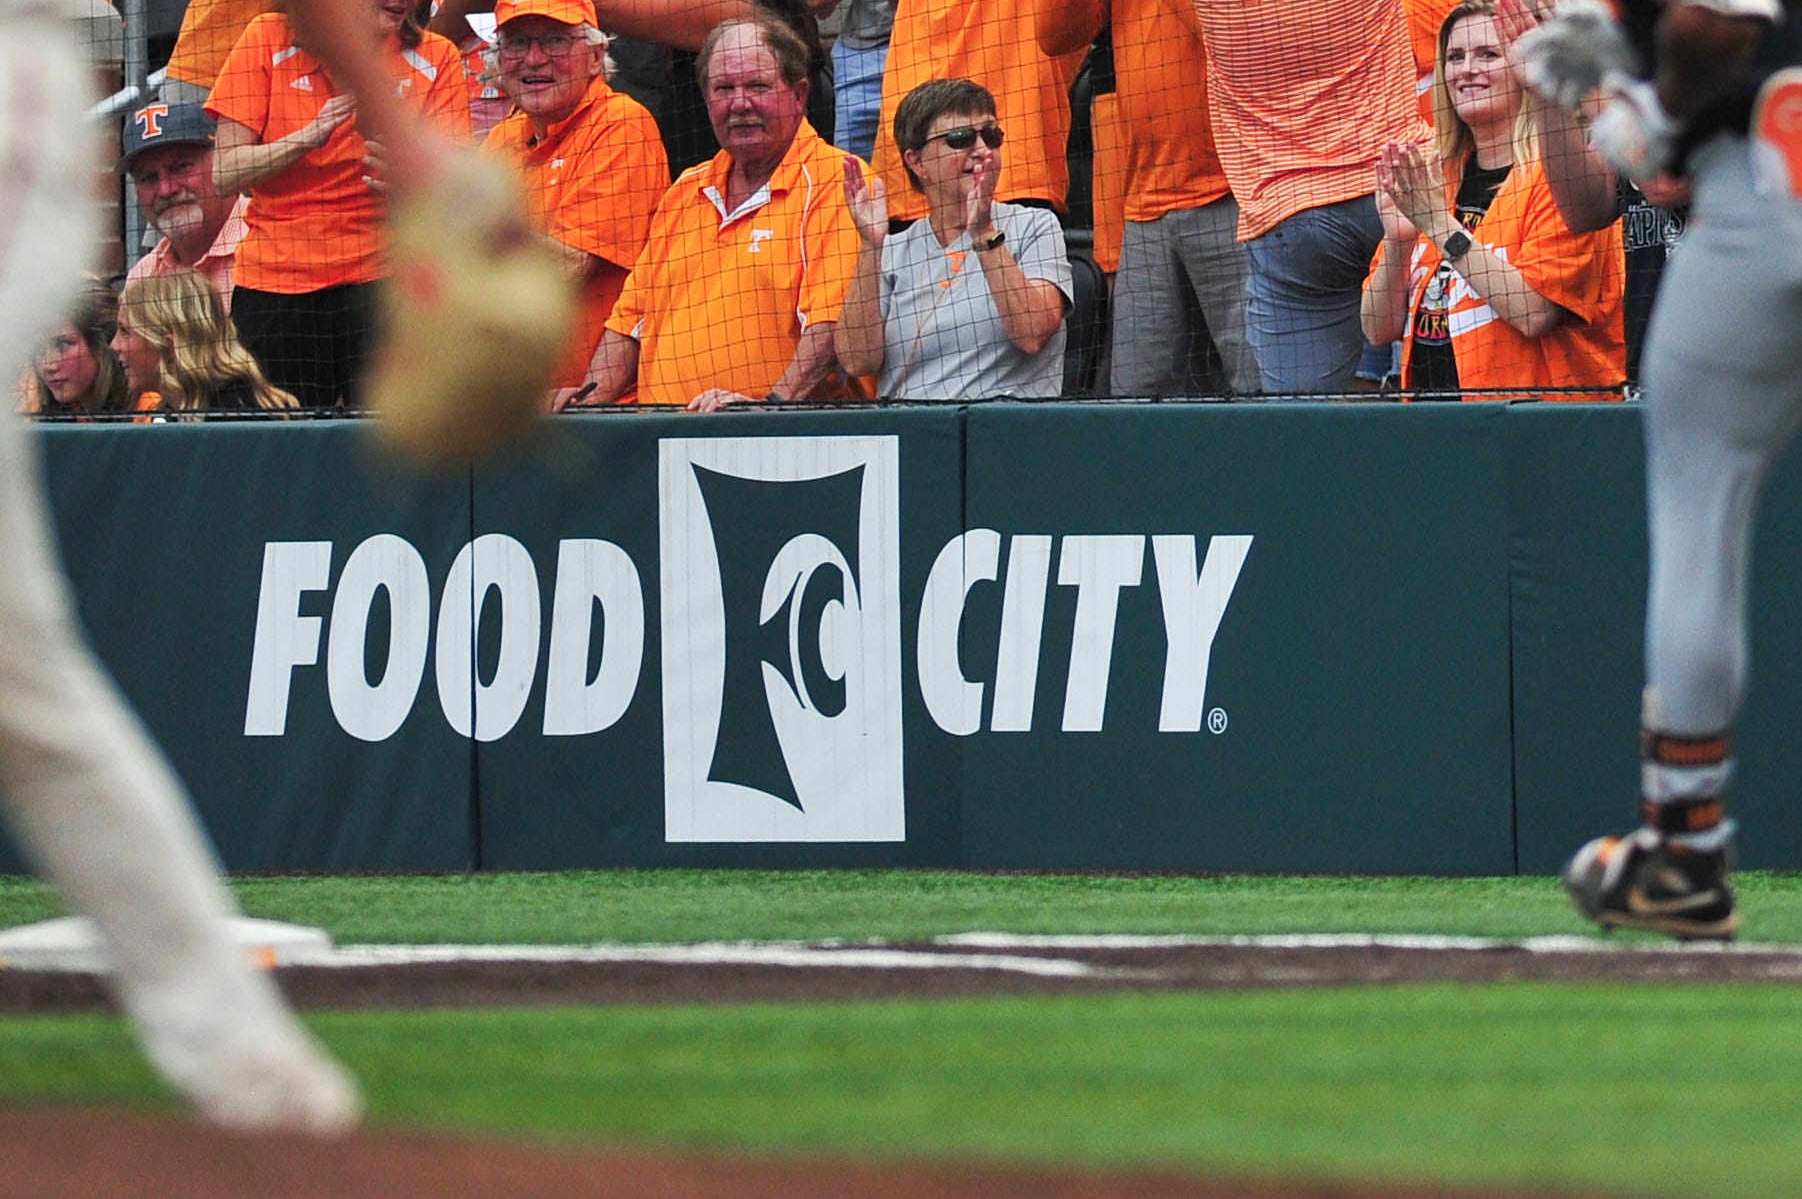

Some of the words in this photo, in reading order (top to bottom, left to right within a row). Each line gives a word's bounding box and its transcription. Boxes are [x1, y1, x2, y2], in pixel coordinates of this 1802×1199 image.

[135, 104, 169, 140] T
[748, 229, 775, 253] T
[945, 252, 967, 273] T
[244, 533, 645, 742] FOOD
[916, 529, 1254, 736] CITY
